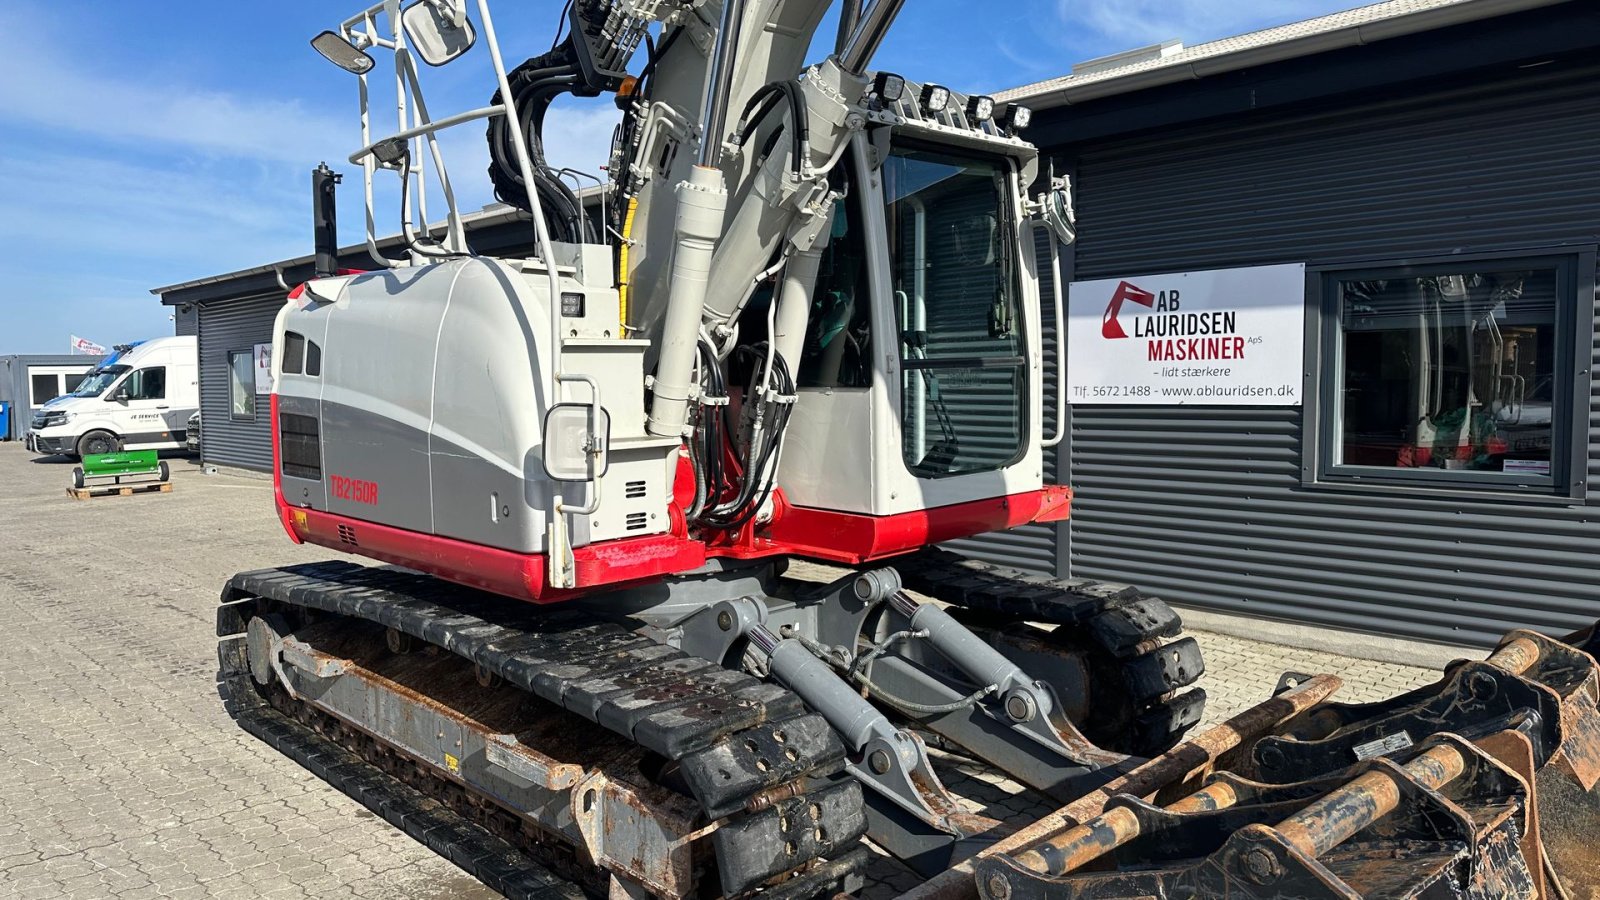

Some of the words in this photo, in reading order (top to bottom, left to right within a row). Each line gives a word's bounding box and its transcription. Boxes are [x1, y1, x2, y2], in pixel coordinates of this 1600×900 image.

[1157, 290, 1180, 312] AB
[1135, 311, 1236, 338] LAURIDSEN
[1148, 336, 1245, 361] MASKINER
[1247, 335, 1263, 344] ApS
[1161, 366, 1179, 377] lidt
[1181, 366, 1231, 377] stærkere
[1073, 386, 1090, 398] Tlf.
[1093, 386, 1120, 397] 5672
[1122, 386, 1151, 397] 1488
[1162, 384, 1294, 397] www.ablauridsen.dk
[330, 475, 378, 506] TB2150R
